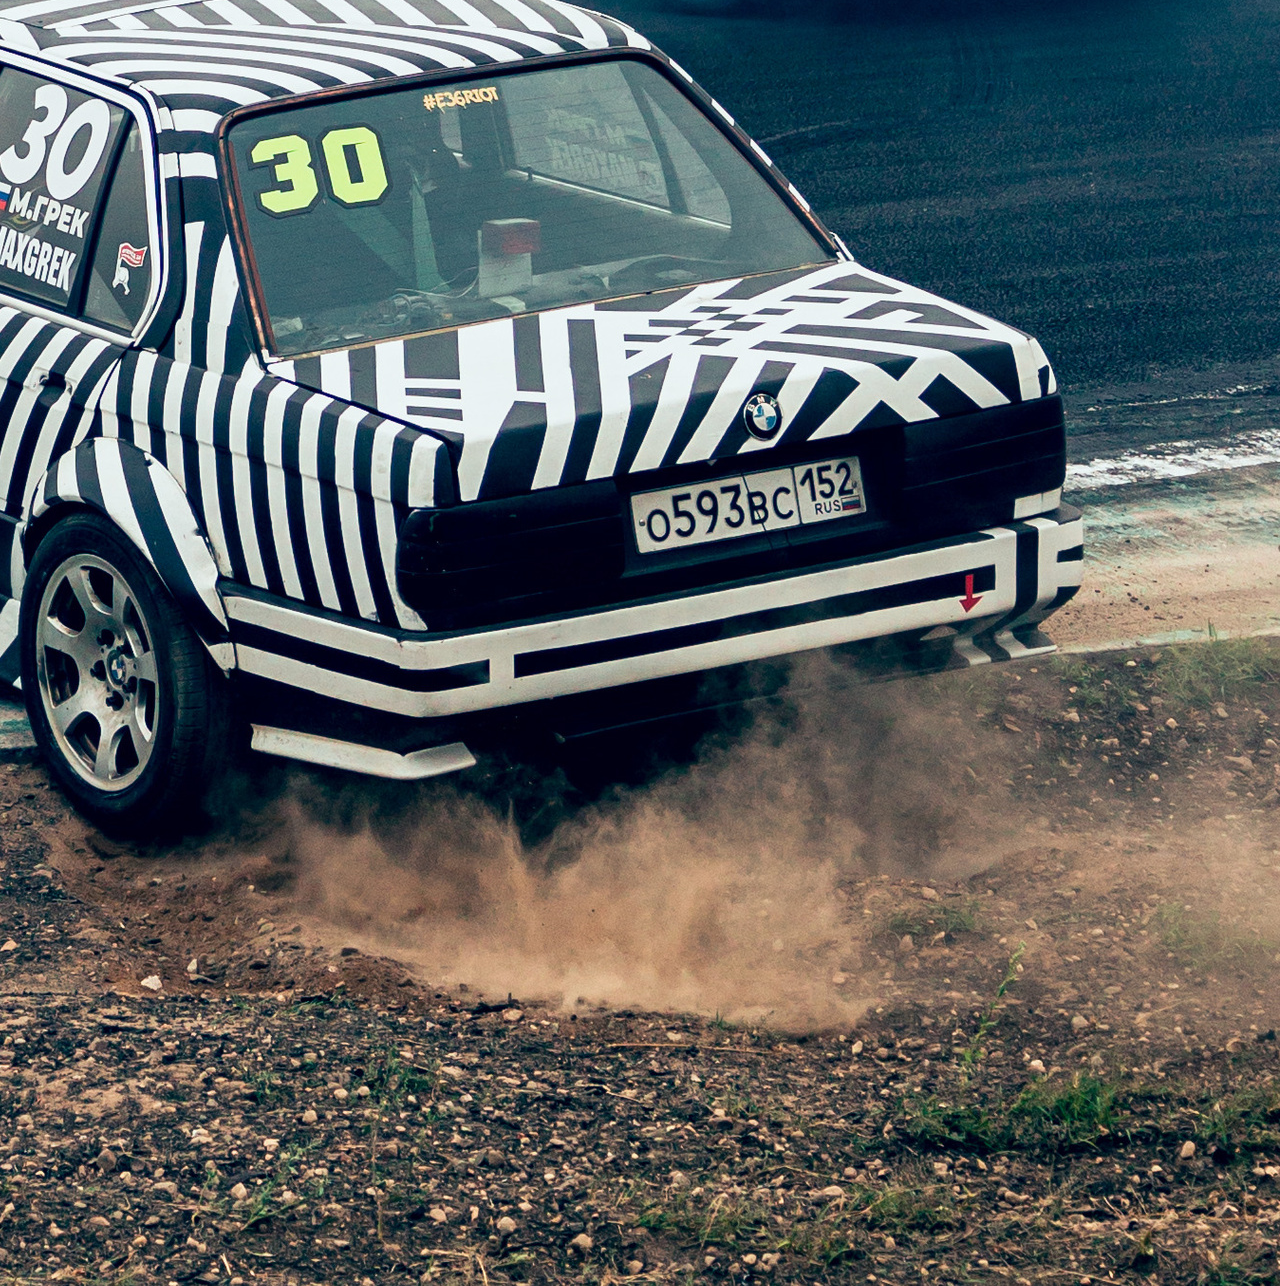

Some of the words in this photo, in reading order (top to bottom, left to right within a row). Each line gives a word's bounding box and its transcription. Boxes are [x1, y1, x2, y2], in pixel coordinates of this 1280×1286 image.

[423, 87, 498, 114] #E36RIOT
[0, 84, 111, 201] 30
[249, 125, 391, 215] 30
[9, 187, 90, 239] М.ГРЕК
[799, 461, 854, 503] 152
[815, 499, 841, 515] RUS
